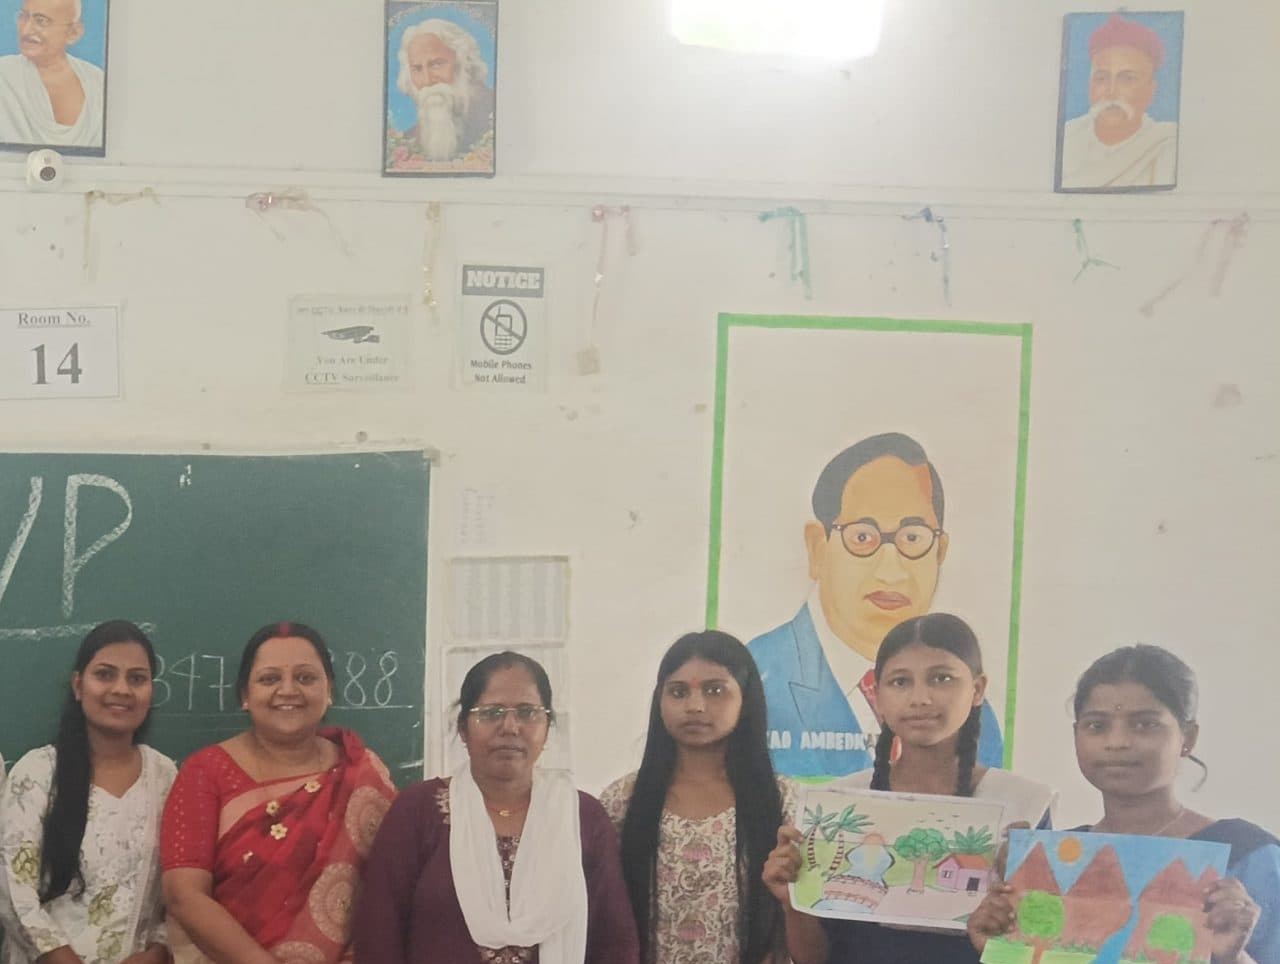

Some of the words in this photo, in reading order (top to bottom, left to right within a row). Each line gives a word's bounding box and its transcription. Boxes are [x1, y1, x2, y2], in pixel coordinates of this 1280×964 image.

[466, 270, 540, 290] NOTICE
[18, 312, 60, 326] Room
[66, 311, 91, 326] No.
[28, 342, 83, 385] 14
[470, 359, 499, 369] Mobile
[501, 359, 532, 370] Phones
[304, 372, 339, 384] CCTV
[474, 373, 490, 384] Not
[492, 373, 526, 384] Allowed
